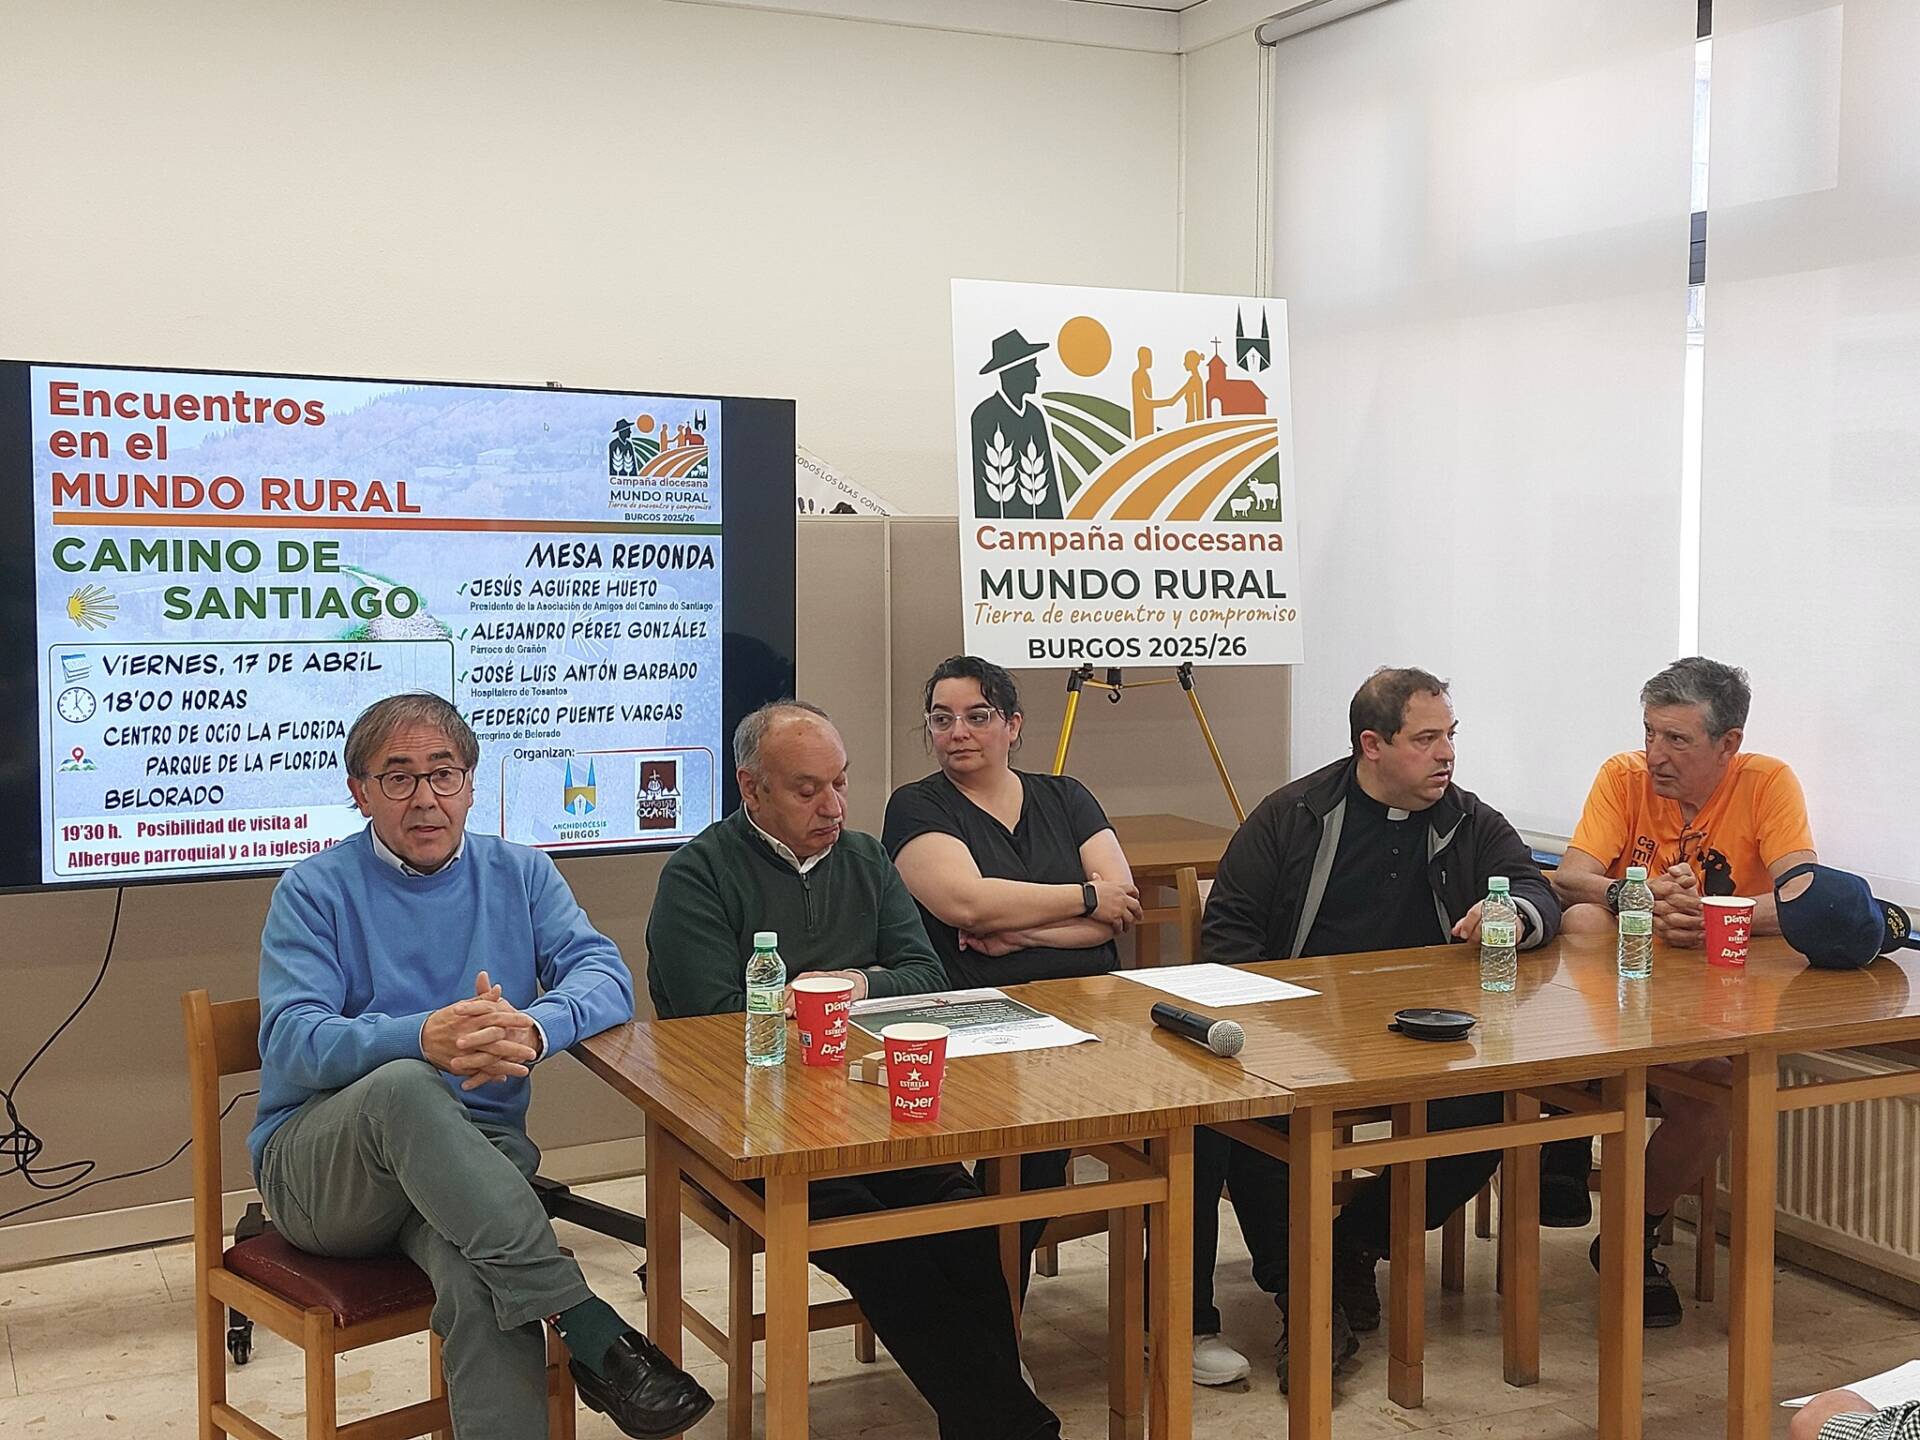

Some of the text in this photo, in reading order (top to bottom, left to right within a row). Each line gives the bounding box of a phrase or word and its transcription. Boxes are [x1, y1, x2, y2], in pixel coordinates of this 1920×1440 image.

[49, 381, 325, 426] Encuentros
[49, 426, 167, 460] en el
[609, 477, 708, 489] Campaña diocesana
[820, 471, 838, 486] LOS
[52, 473, 421, 513] MUNDO RURAL
[611, 490, 708, 503] MUNDO RURAL
[624, 512, 695, 522] BURGOS 2025/26
[976, 525, 1284, 556] Campaña diocesana
[52, 537, 340, 573] CAMINO DE
[525, 543, 715, 570] MESA REDONDA
[470, 573, 523, 597] JESÚS
[606, 579, 657, 597] HUETO
[980, 569, 1287, 600] MUNDO RURAL
[163, 586, 419, 620] SANTIAGO
[470, 602, 513, 611] Presidente
[516, 602, 526, 611] de
[536, 601, 581, 611] Asociación
[582, 602, 592, 611] de
[594, 602, 623, 613] Amigos
[625, 602, 637, 611] del
[639, 602, 668, 611] Camino
[669, 602, 679, 611] de
[681, 602, 713, 612] Santiago
[471, 616, 707, 640] ALEJANDRO PÉREZ GONZÁLEZ
[974, 603, 1297, 629] Tierra de encuentro y compromiso
[470, 645, 503, 655] Párroco
[505, 645, 515, 653] de
[1028, 633, 1247, 659] BURGOS 2025/26
[232, 653, 258, 674] 17
[268, 652, 293, 673] DE
[471, 660, 514, 683] JOSÉ
[563, 658, 617, 682] ANTÓN
[623, 662, 698, 681] BARBADO
[181, 689, 247, 711] HORAS
[470, 686, 568, 698] Hospitalero de Tosantos
[556, 705, 616, 724] PUENTE
[621, 704, 683, 722] VARGAS
[103, 725, 172, 747] CENTRO
[178, 724, 199, 744] DE
[247, 722, 271, 742] LA
[512, 730, 523, 739] de
[525, 729, 561, 739] Belorado
[146, 754, 212, 776] PARQUE
[218, 754, 238, 774] DE
[244, 753, 263, 773] LA
[514, 748, 576, 762] Organizan:
[104, 785, 224, 810] BELORADO
[107, 823, 122, 840] h.
[137, 817, 224, 838] Posibilidad
[227, 816, 246, 834] de
[249, 815, 291, 832] visita
[294, 813, 307, 829] al
[560, 829, 600, 840] BURGOS
[68, 846, 140, 869] Albergue
[144, 842, 226, 866] parroquial
[229, 846, 238, 861] y
[240, 845, 249, 858] a
[253, 841, 267, 857] la
[270, 838, 320, 857] iglesia
[893, 1050, 934, 1065] papel
[895, 1096, 934, 1110] paper
